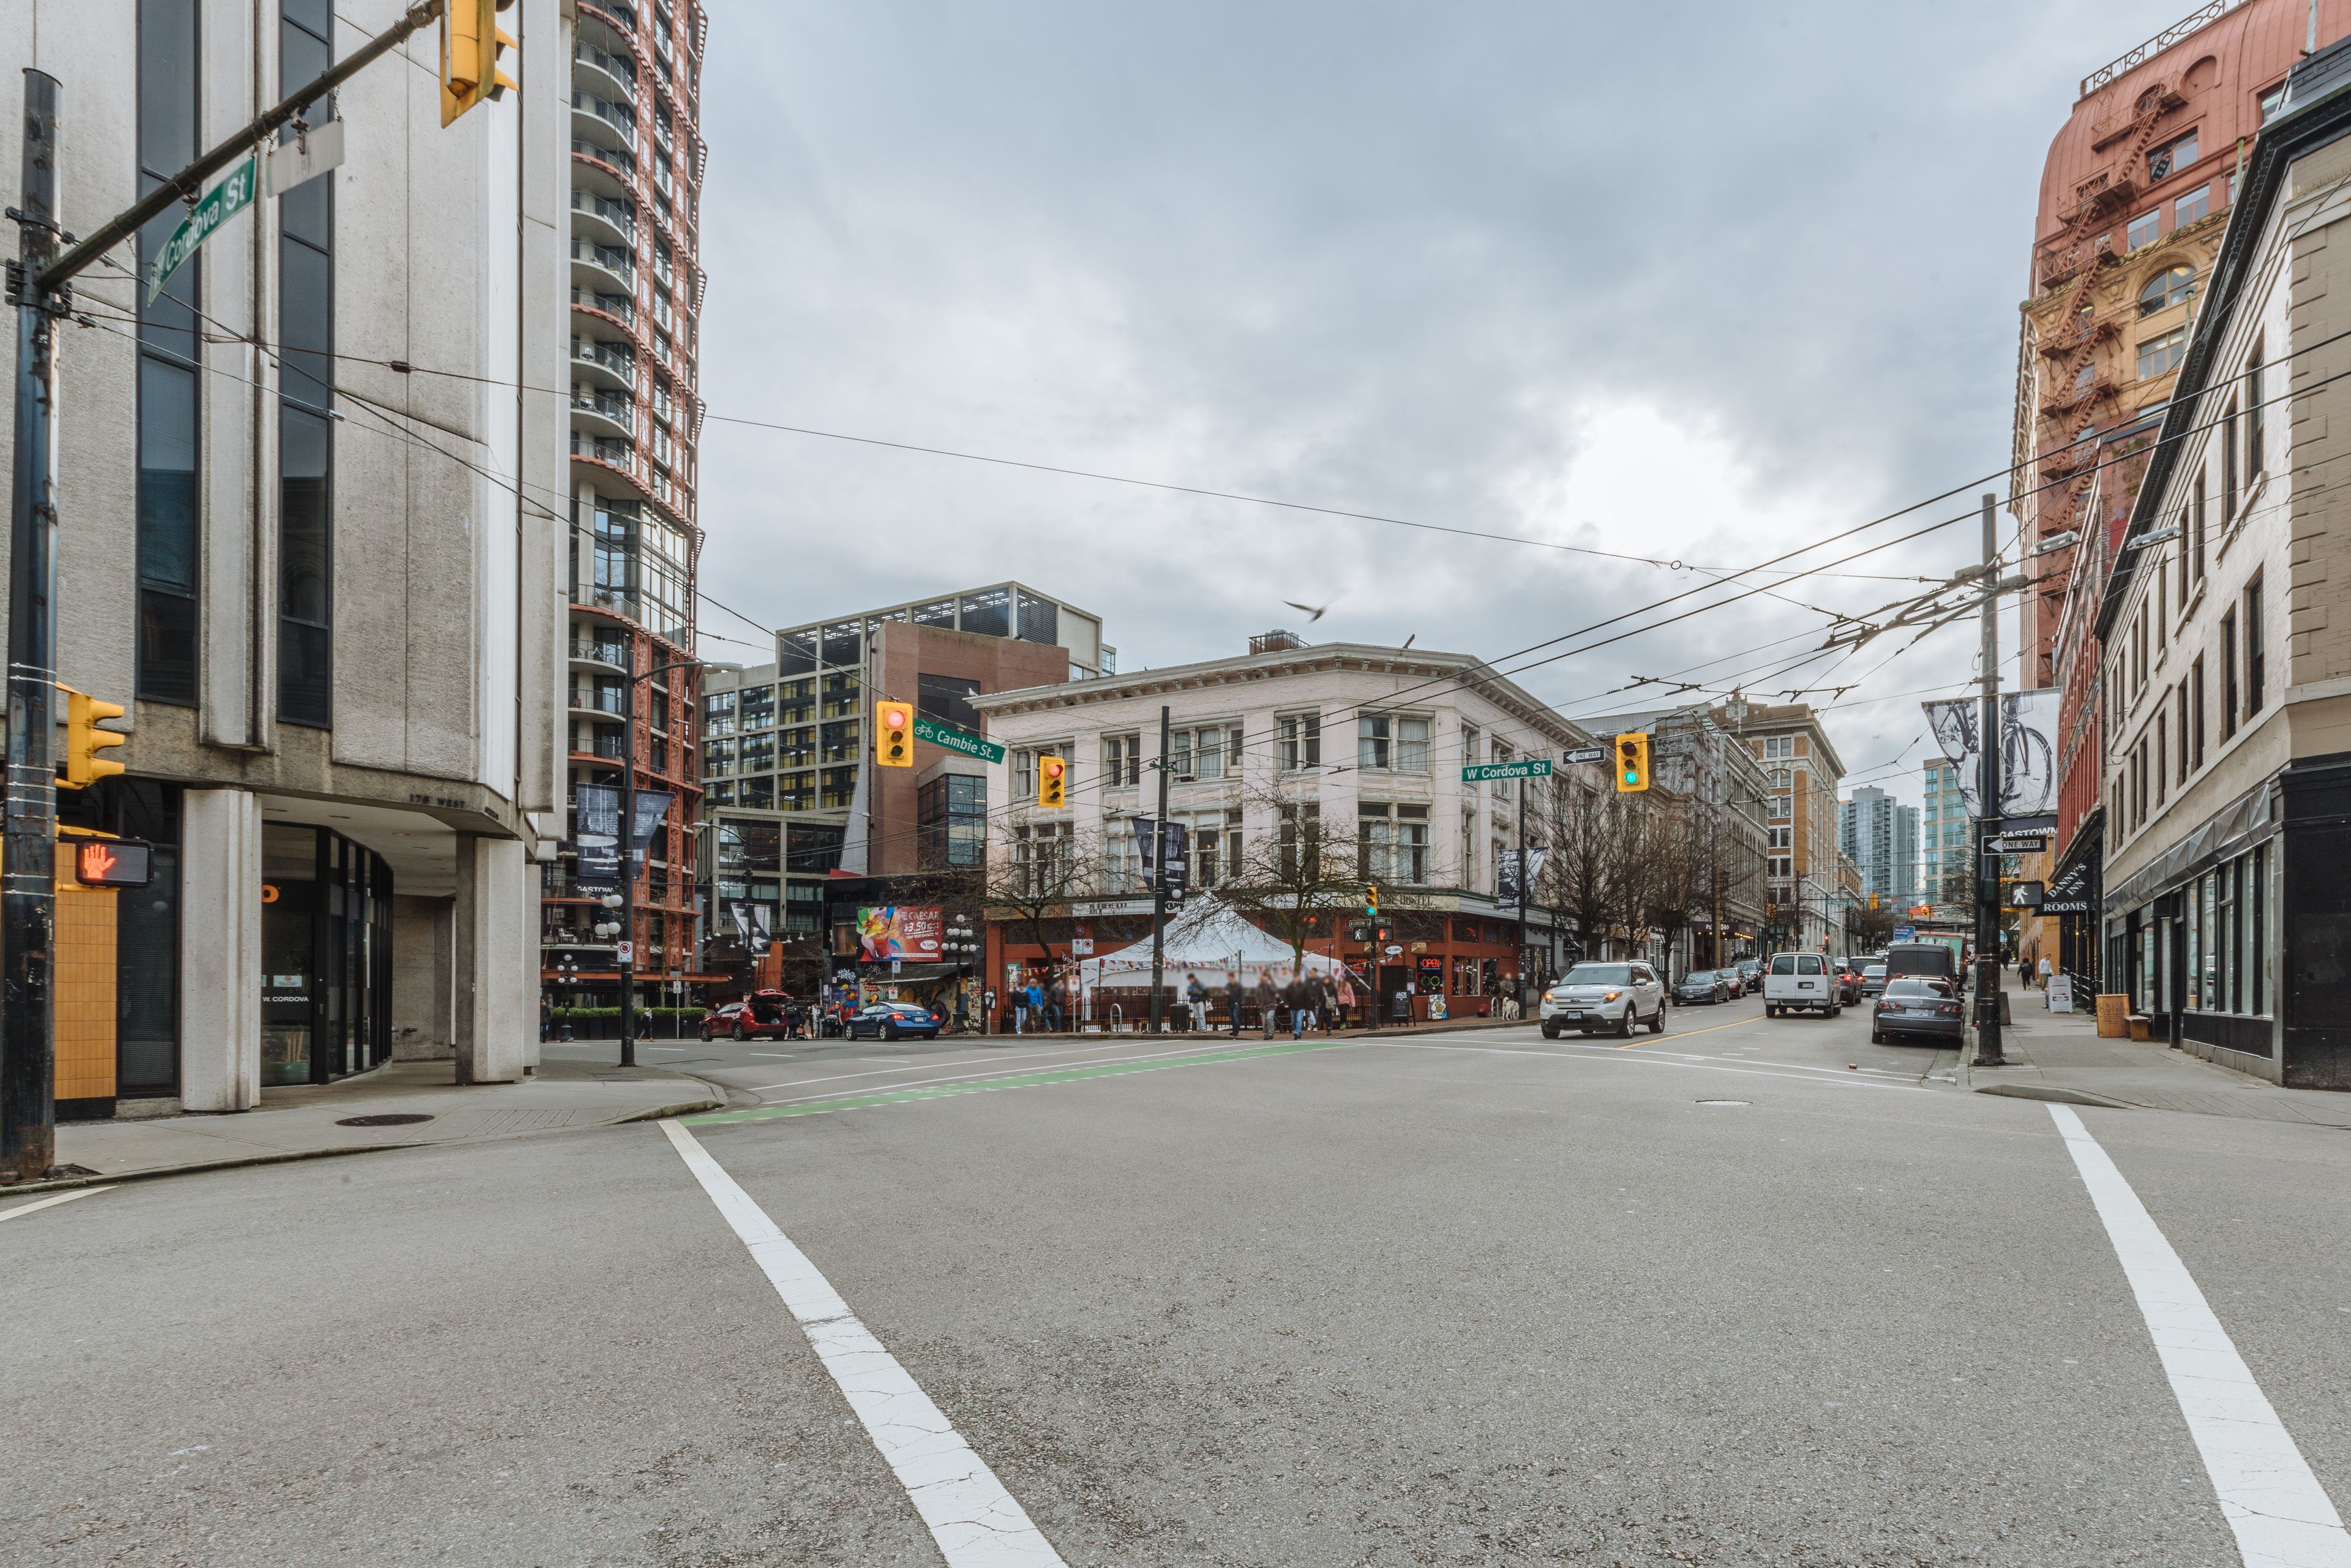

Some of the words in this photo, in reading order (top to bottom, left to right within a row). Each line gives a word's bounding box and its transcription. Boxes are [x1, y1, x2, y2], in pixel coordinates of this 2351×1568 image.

[165, 200, 219, 271] Cordova
[226, 173, 246, 211] St
[937, 730, 978, 753] Cambie
[979, 744, 994, 759] St.
[1467, 768, 1477, 779] W
[1482, 765, 1528, 778] Cordova
[1532, 762, 1546, 775] St
[2047, 863, 2087, 898] DANNY'S
[2066, 879, 2085, 896] INN
[1400, 894, 1433, 906] HOSTEL
[2043, 902, 2087, 912] ROOMS
[1422, 958, 1441, 968] OPEN
